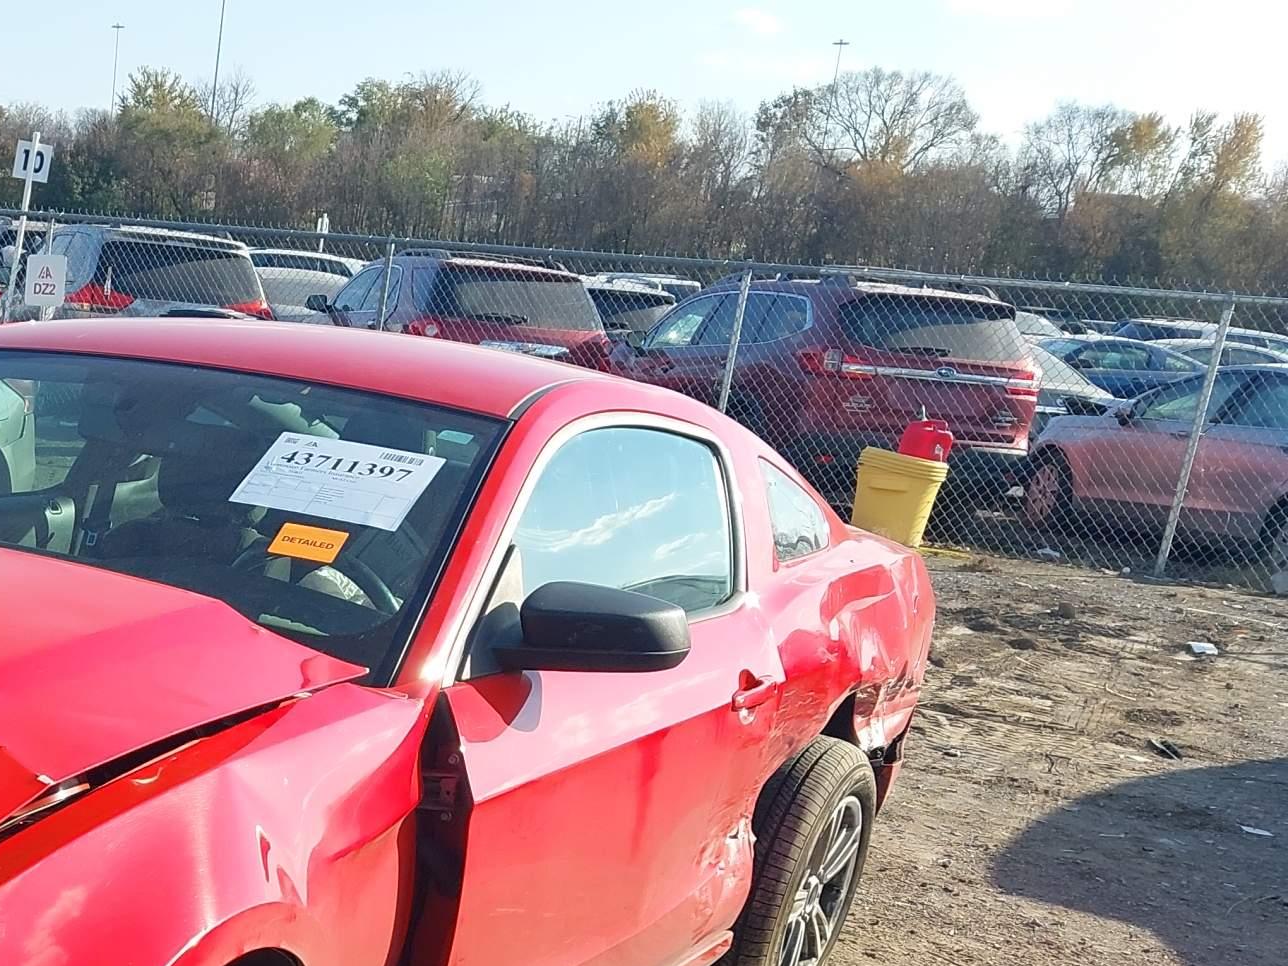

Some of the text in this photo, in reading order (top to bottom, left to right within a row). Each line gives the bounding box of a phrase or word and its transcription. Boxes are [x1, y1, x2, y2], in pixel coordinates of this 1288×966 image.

[33, 282, 56, 296] DZ2
[280, 450, 415, 482] 43711397
[281, 535, 335, 550] DETAILED
